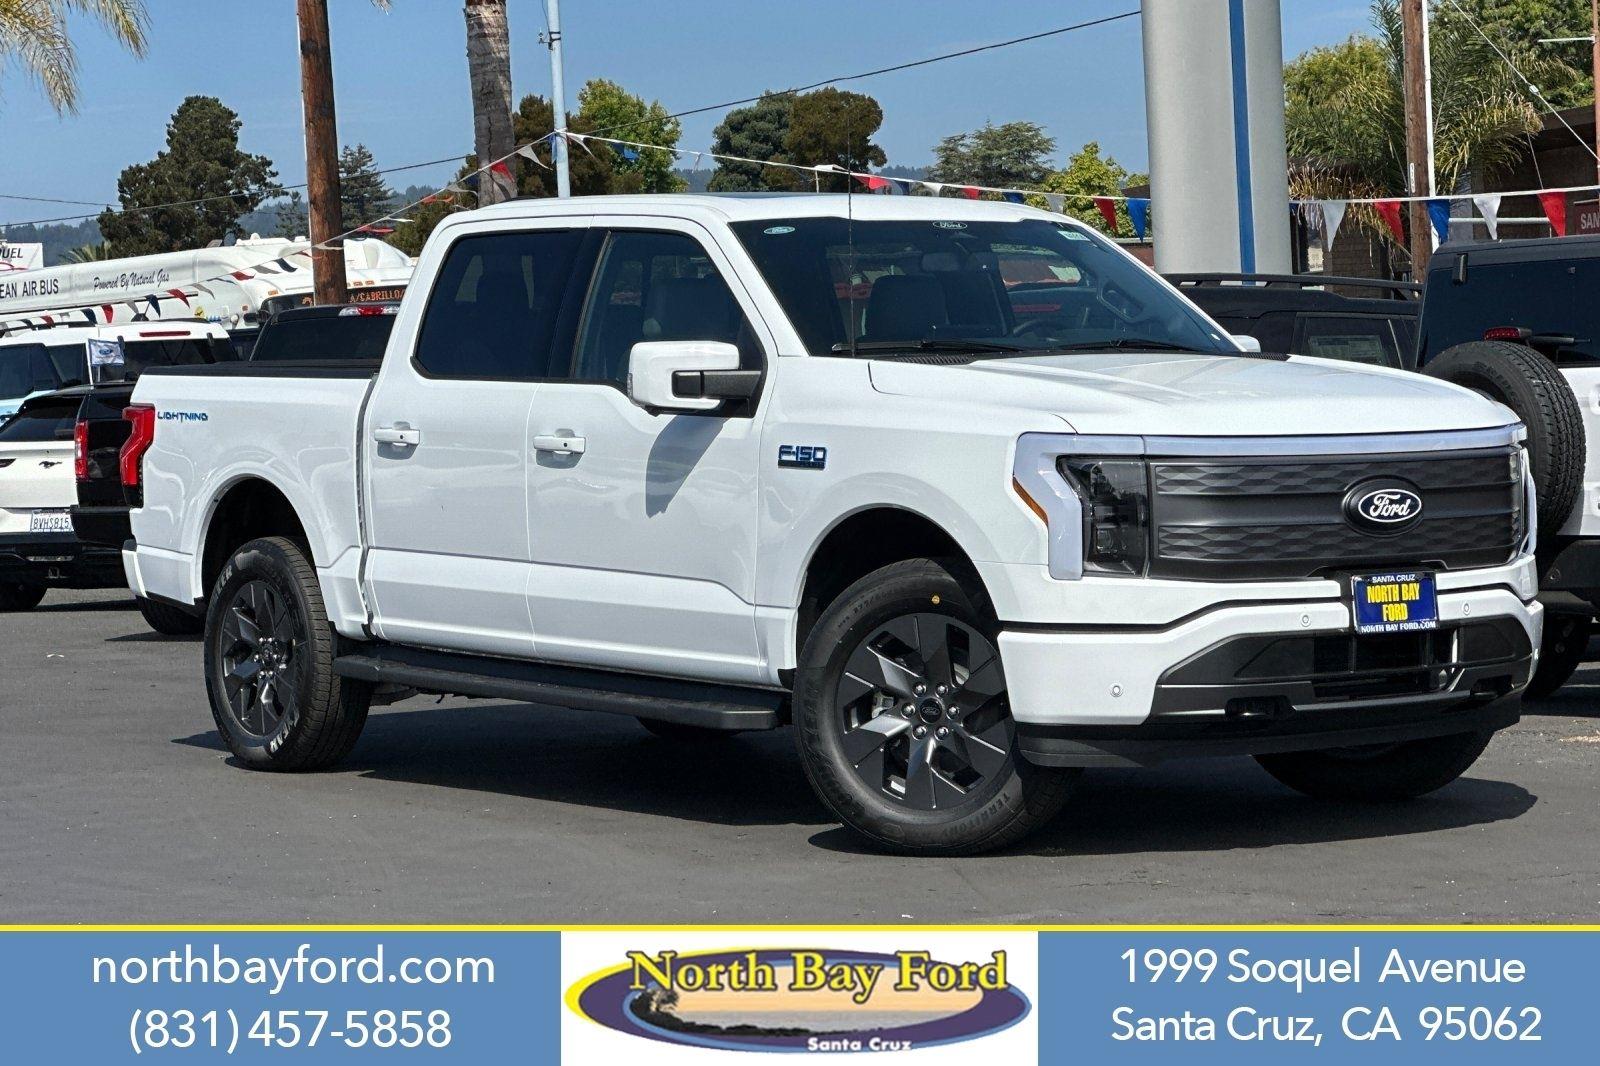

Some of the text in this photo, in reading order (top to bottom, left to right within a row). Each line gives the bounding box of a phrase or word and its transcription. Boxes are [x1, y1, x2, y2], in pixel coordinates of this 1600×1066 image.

[0, 247, 24, 259] UEL
[22, 280, 38, 297] AIR
[40, 279, 59, 295] BUS
[93, 268, 170, 292] Powered By Natural Gas
[157, 411, 209, 423] LIGHTNING
[778, 445, 827, 462] F-150
[1369, 493, 1411, 518] Ford
[1372, 574, 1416, 583] SANTA CRUZ
[1366, 583, 1420, 603] NORTH BAY
[1382, 602, 1408, 622] FORD
[1360, 620, 1436, 633] NORTH BAY FORD.COM
